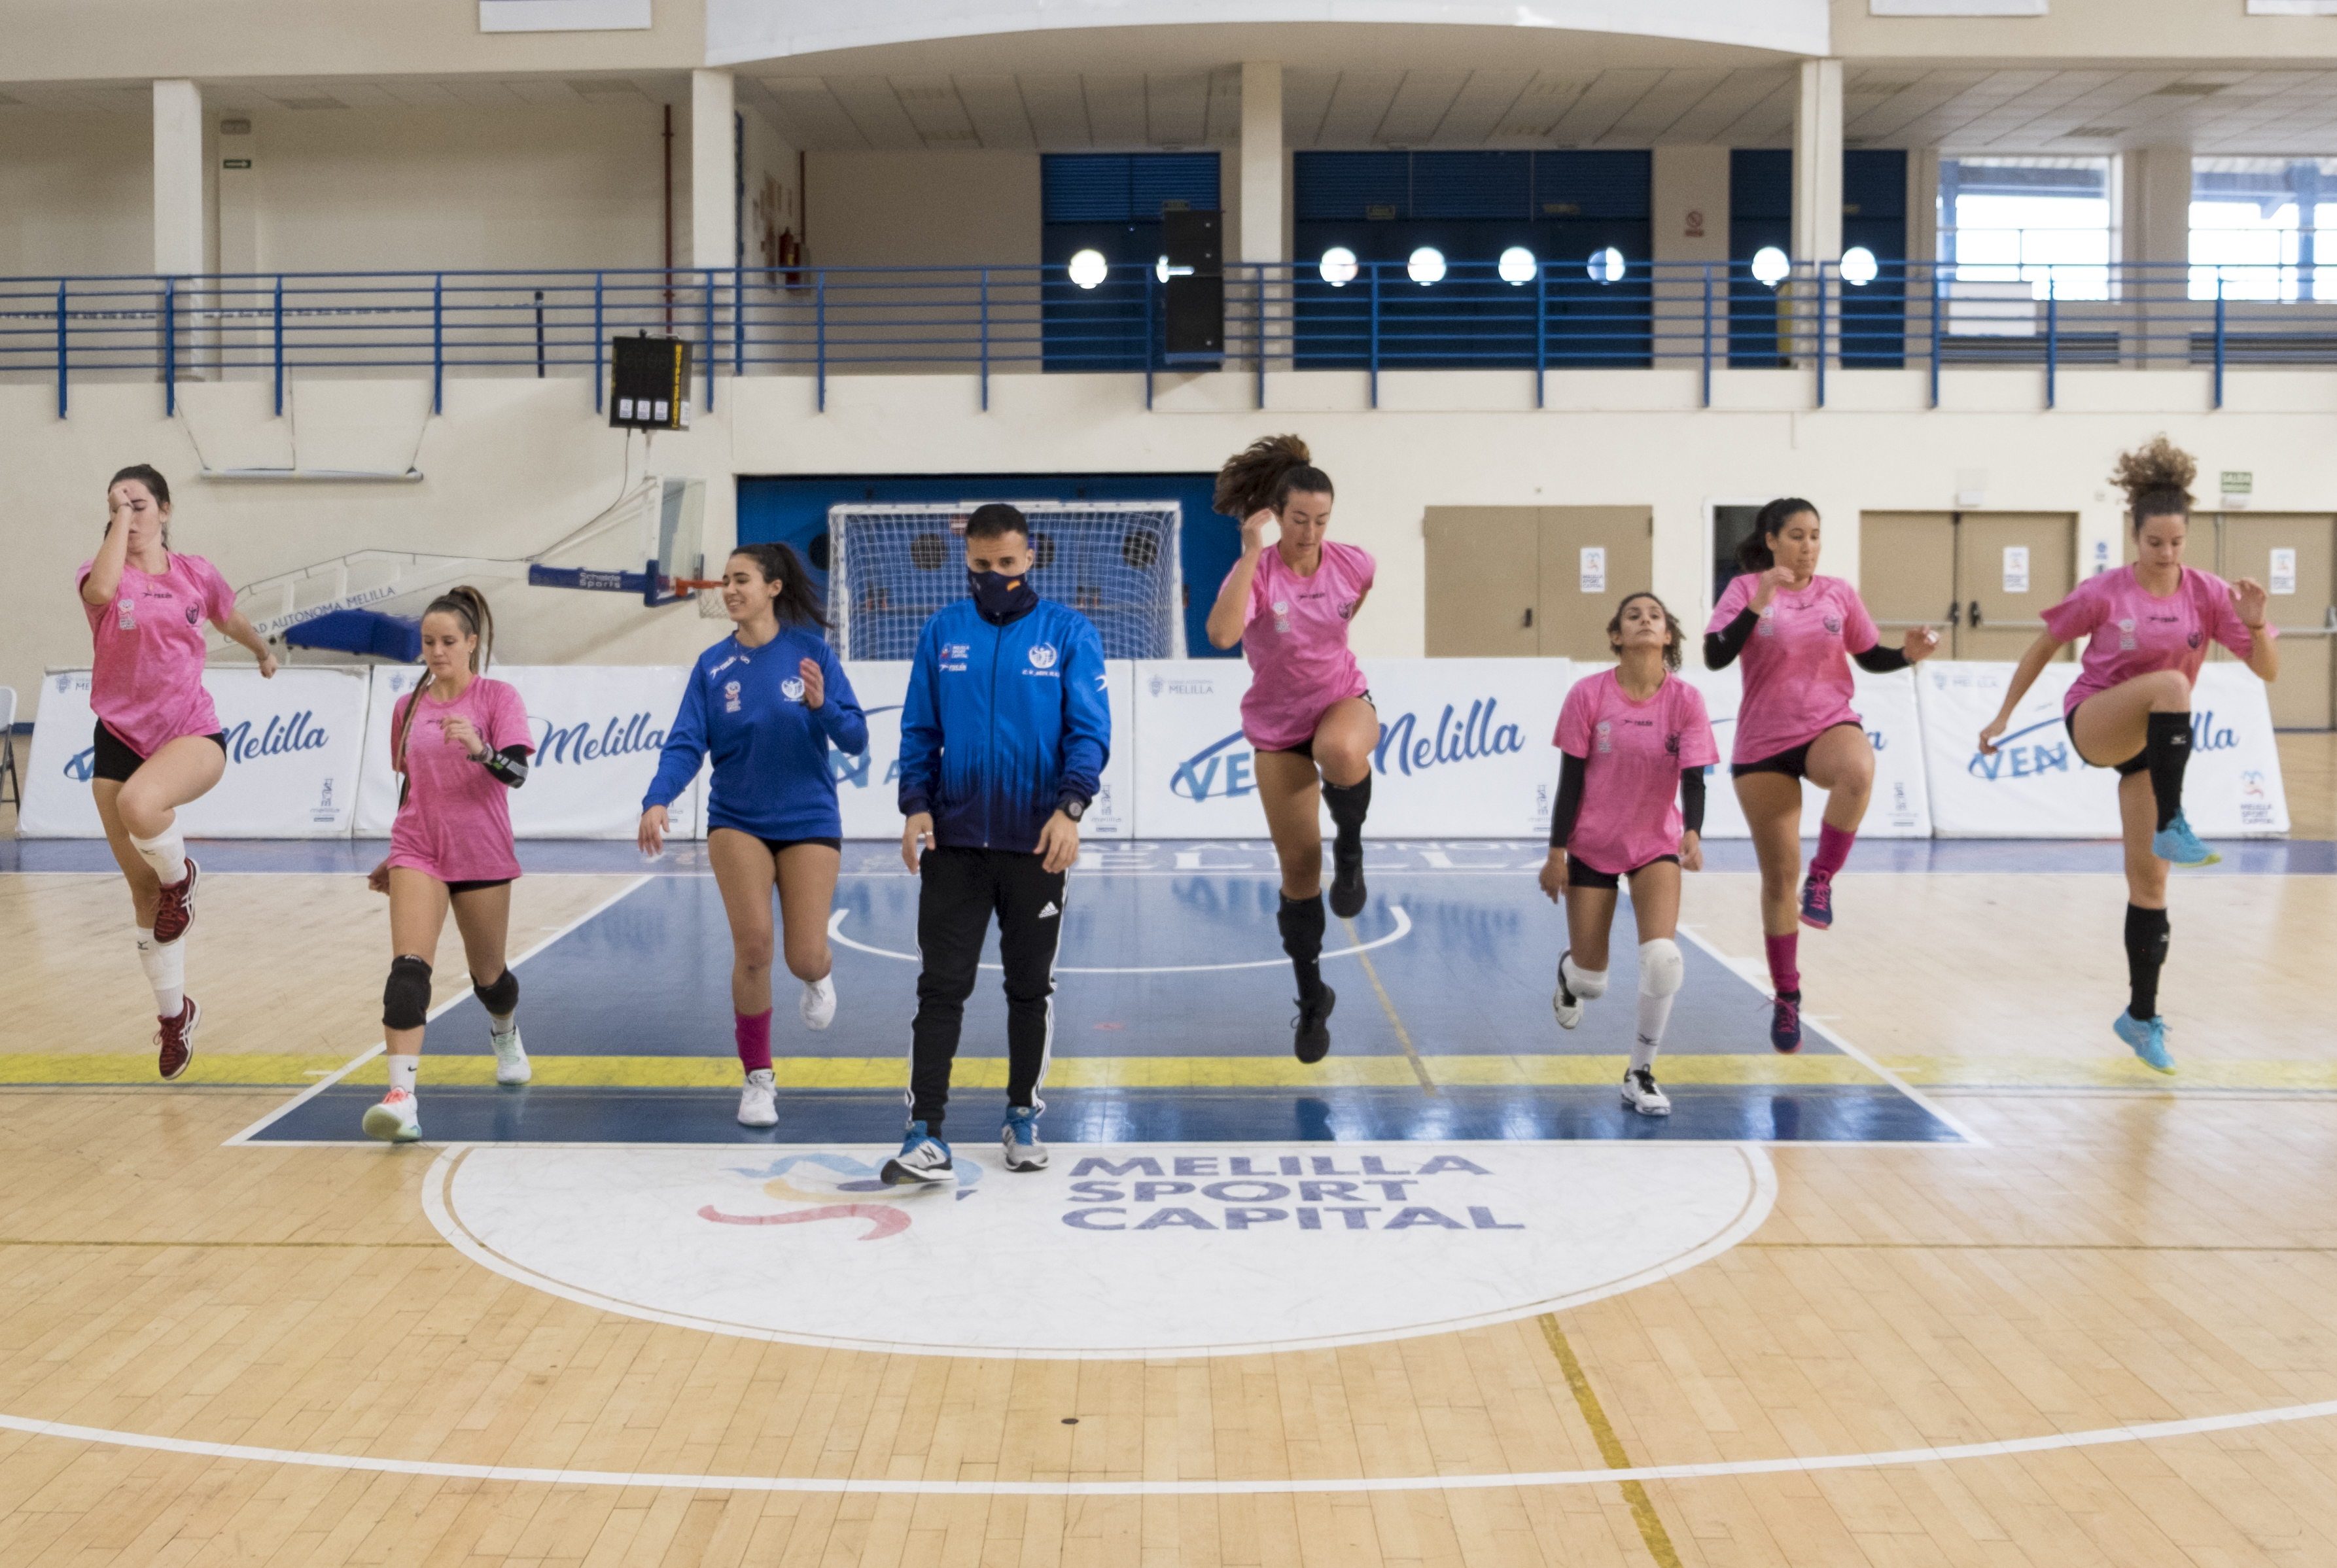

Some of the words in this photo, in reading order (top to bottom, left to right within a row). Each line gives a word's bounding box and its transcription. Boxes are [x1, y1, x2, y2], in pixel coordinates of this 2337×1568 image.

[346, 587, 395, 608] MELILLA
[1169, 685, 1214, 693] MELILLA
[527, 711, 666, 767] Melilla
[1179, 752, 1250, 803] VE
[1068, 1155, 1496, 1177] MELILLA
[1066, 1180, 1418, 1202] SPORT
[1061, 1206, 1526, 1230] CAPITAL
